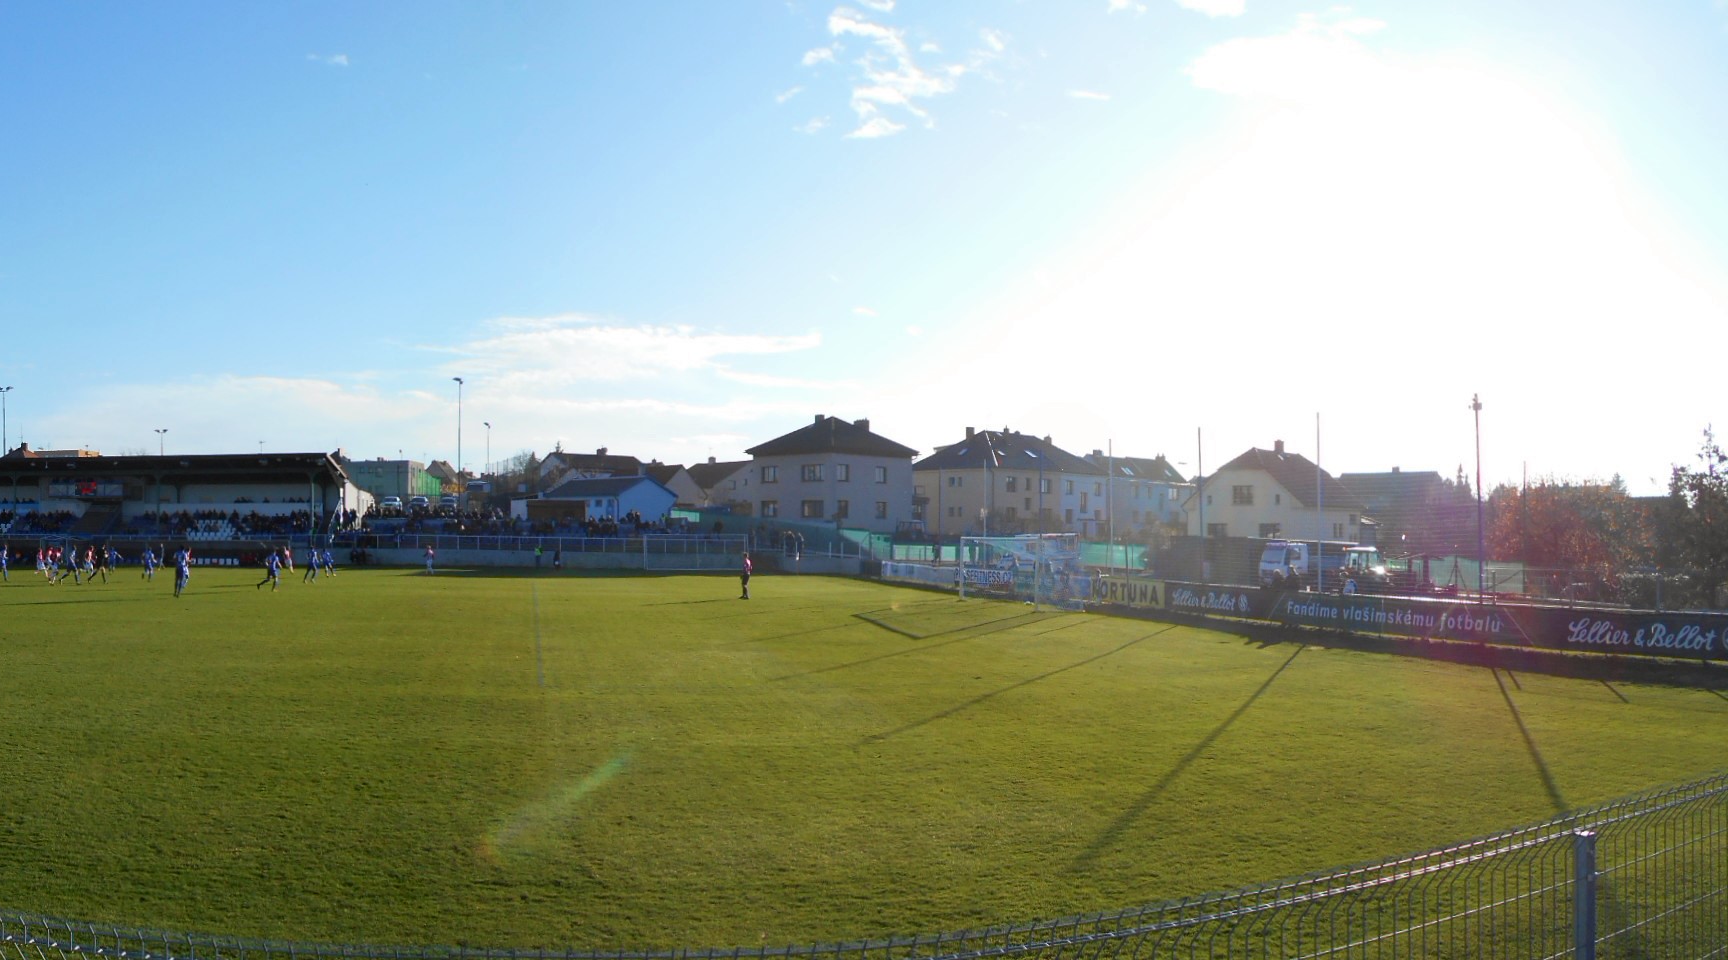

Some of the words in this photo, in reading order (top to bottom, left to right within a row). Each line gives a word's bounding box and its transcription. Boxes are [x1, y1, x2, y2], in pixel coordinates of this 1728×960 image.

[1206, 591, 1237, 611] Bellot
[1286, 600, 1338, 619] Fandíme
[1342, 606, 1434, 627] vlašimskému
[1568, 617, 1631, 645] Sellier
[1634, 628, 1645, 648] &
[1647, 623, 1718, 651] Bellot
